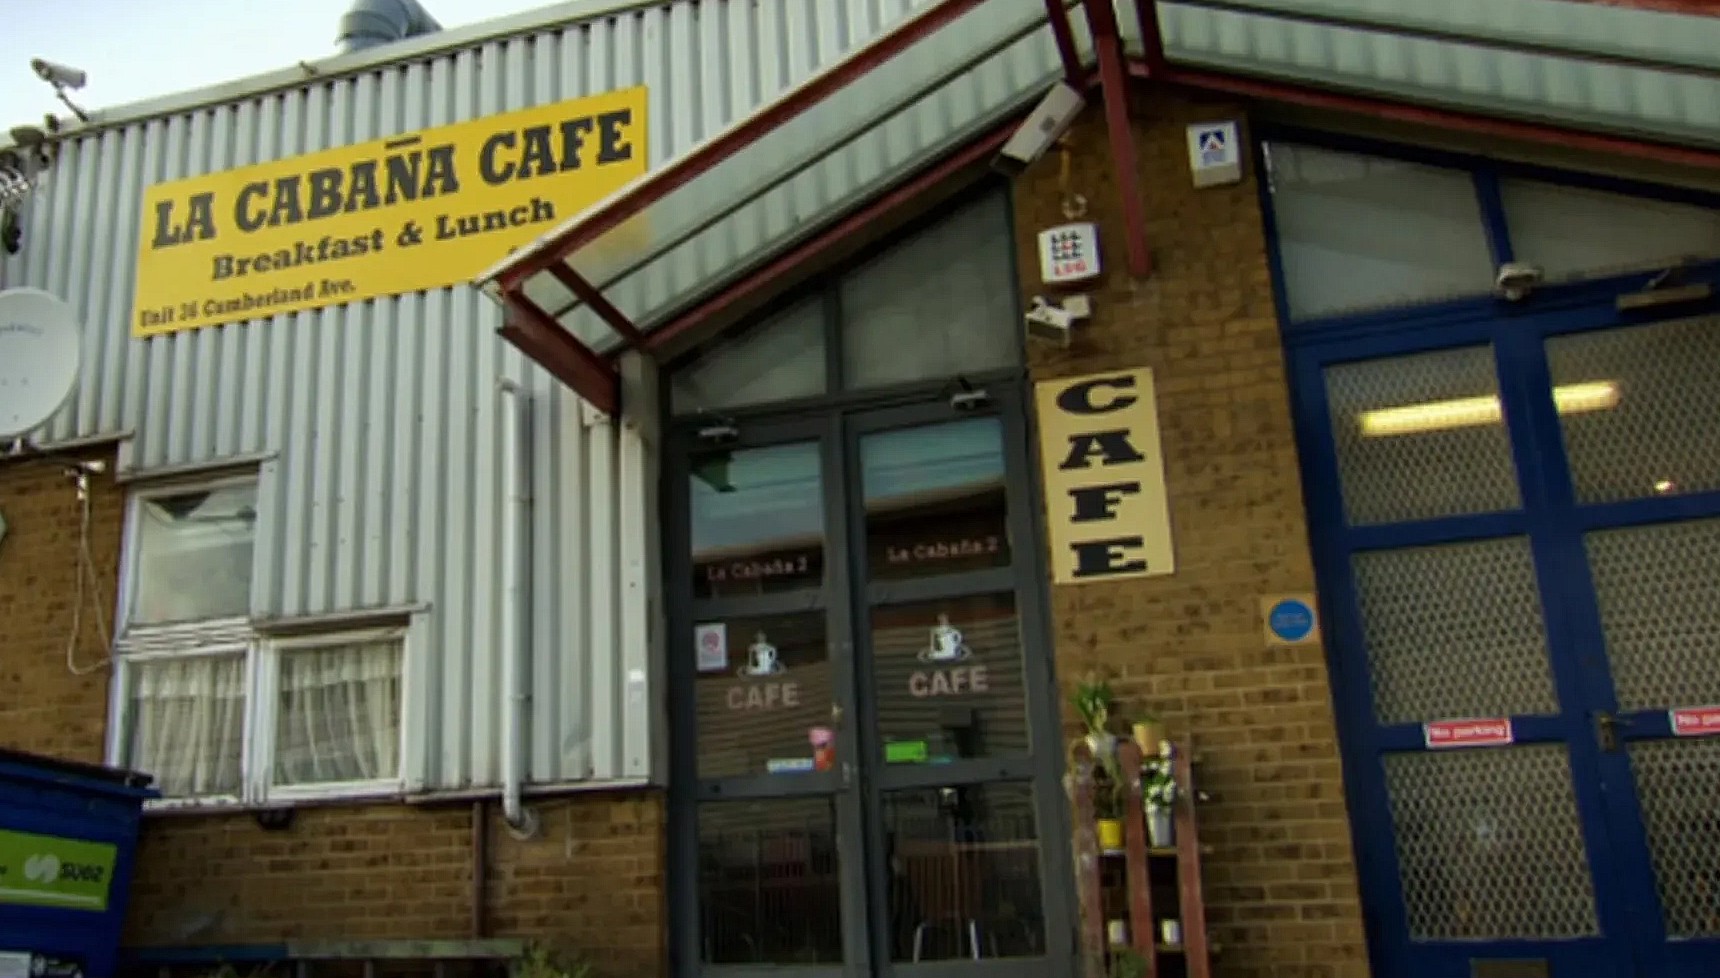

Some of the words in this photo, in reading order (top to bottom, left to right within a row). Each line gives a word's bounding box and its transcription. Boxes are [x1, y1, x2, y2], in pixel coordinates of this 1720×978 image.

[153, 192, 216, 249] LA
[233, 136, 460, 232] CABAÑA
[479, 108, 632, 184] CAFE
[212, 231, 383, 280] Breakfast
[396, 220, 422, 248] &
[435, 197, 556, 240] Lunch
[203, 281, 314, 316] Cumberland
[1056, 374, 1147, 578] CAFE
[888, 547, 909, 563] La
[708, 566, 726, 582] La
[726, 683, 801, 711] CAFE
[909, 665, 989, 697] CAFE
